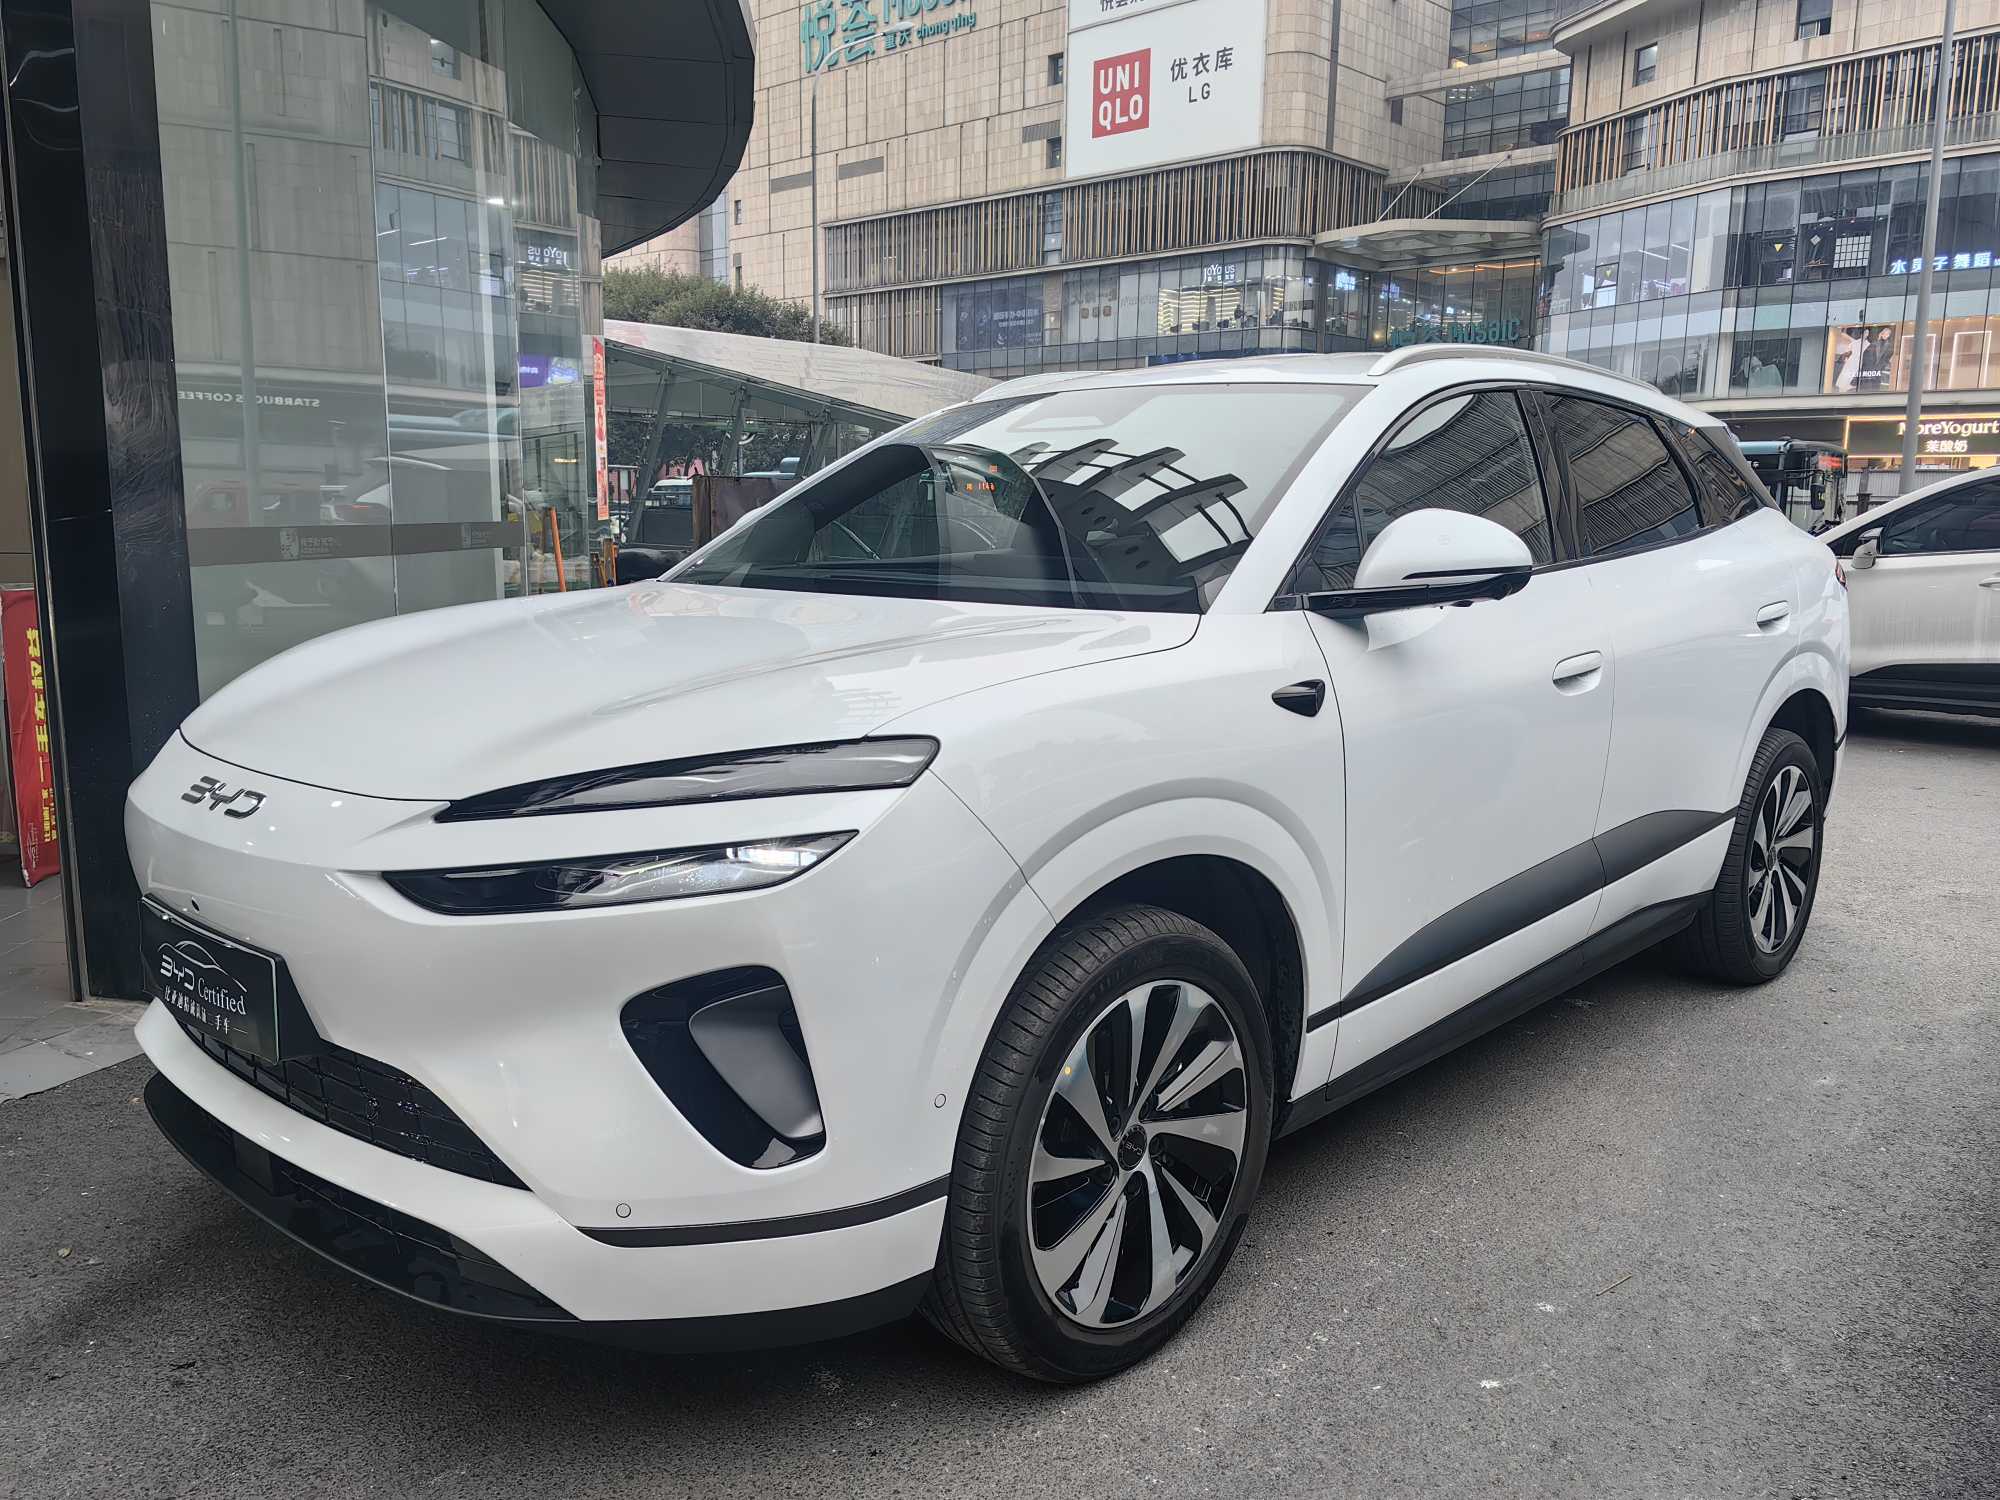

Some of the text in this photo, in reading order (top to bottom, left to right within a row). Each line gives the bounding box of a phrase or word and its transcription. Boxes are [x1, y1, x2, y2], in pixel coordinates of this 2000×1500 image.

[1100, 61, 1140, 95] UNI
[1170, 46, 1234, 82] 优衣库
[1188, 82, 1211, 103] LG
[1098, 94, 1143, 130] QLO
[181, 776, 267, 819] BYD
[160, 954, 246, 1015] BYD Certified
